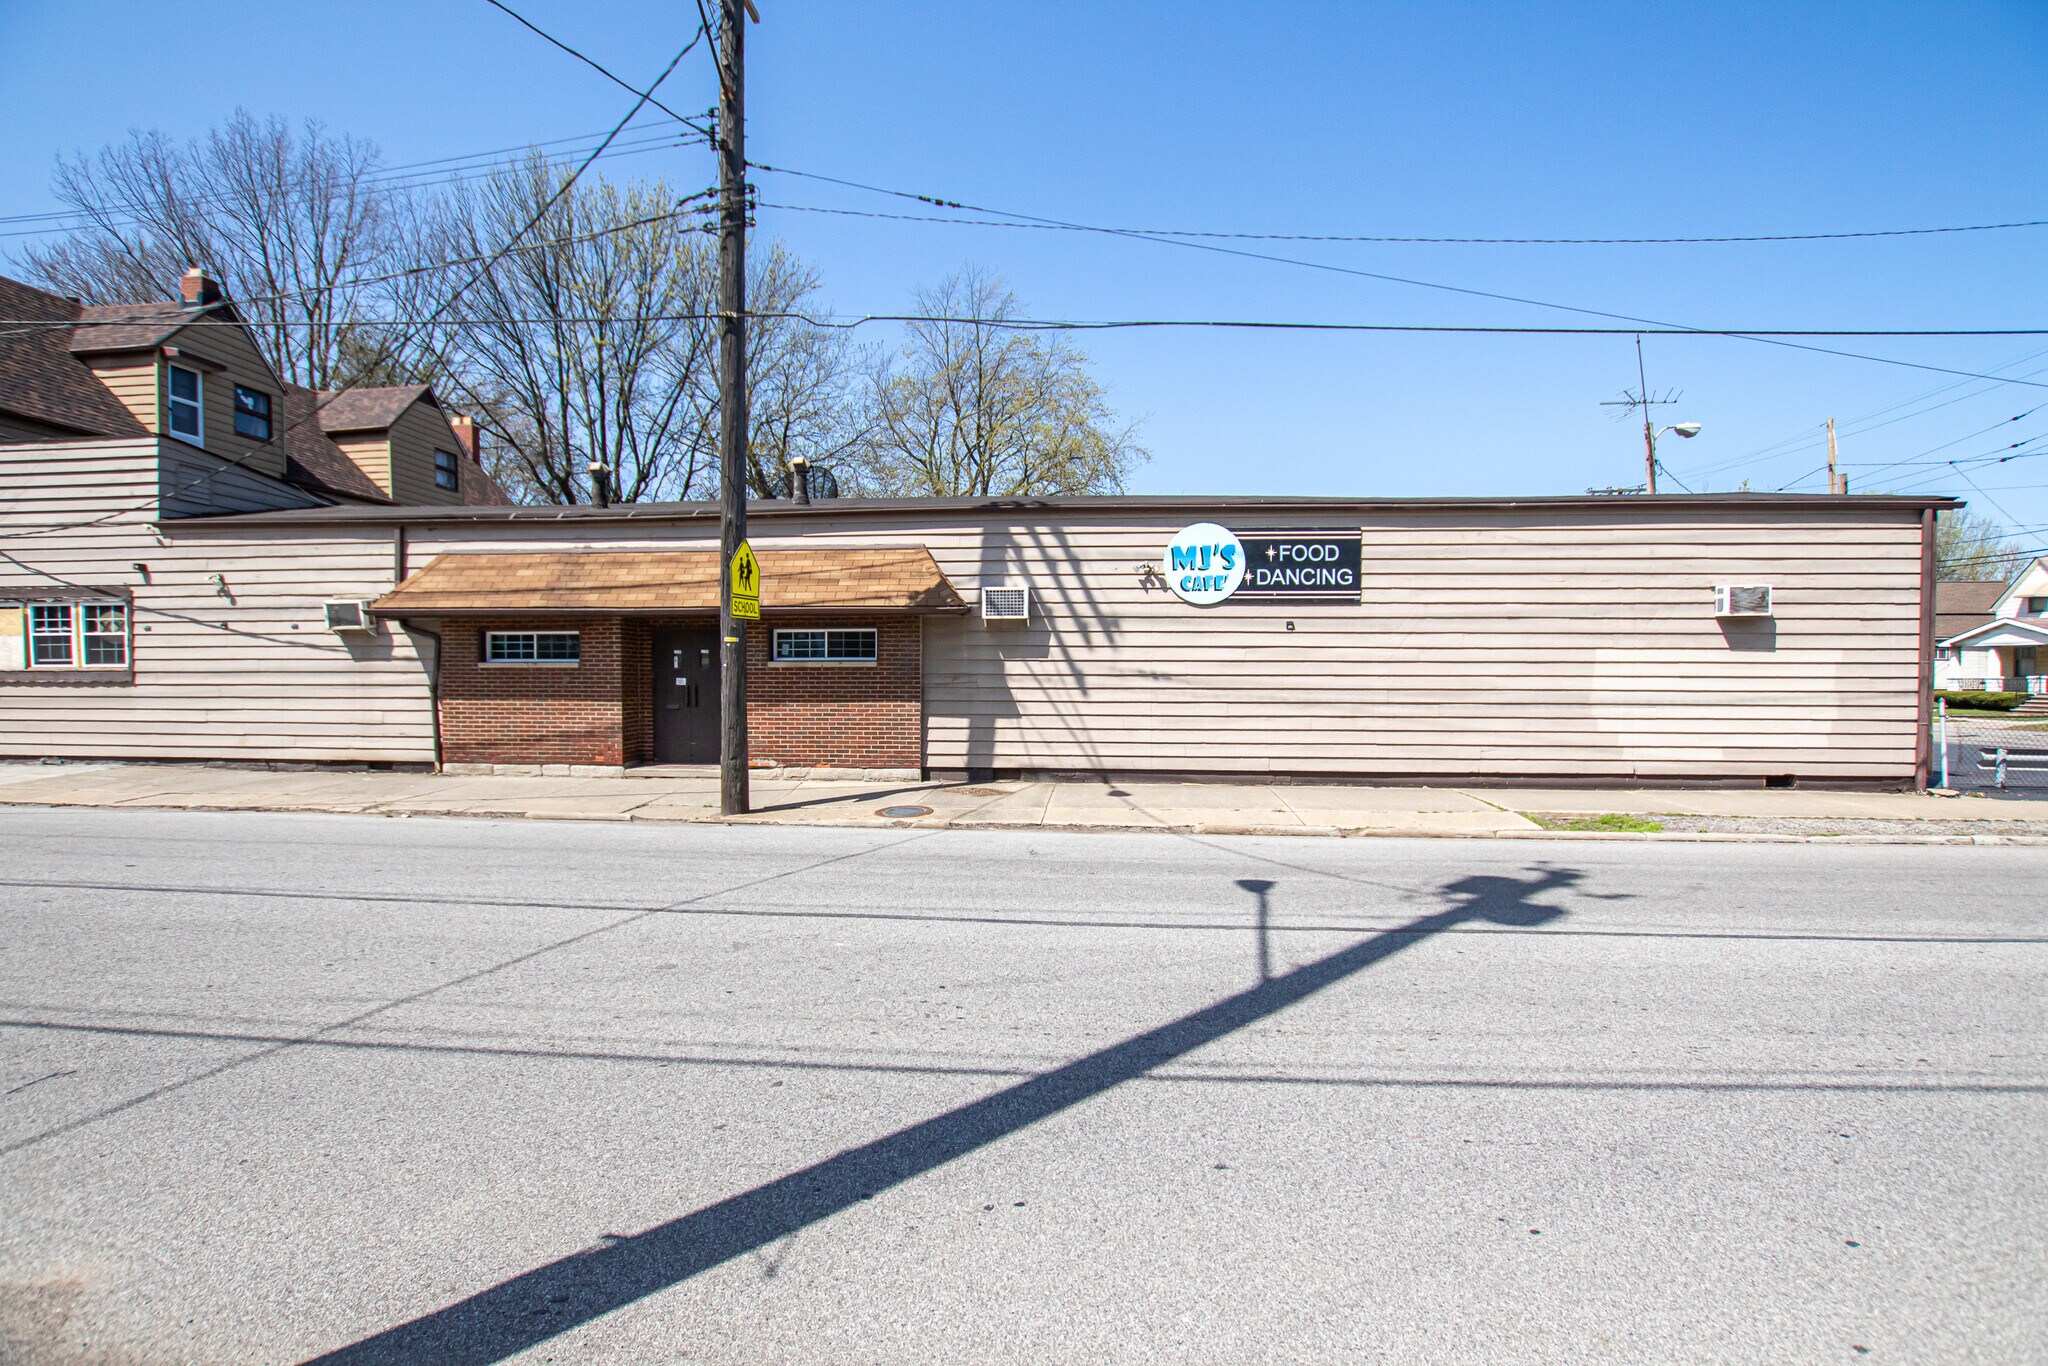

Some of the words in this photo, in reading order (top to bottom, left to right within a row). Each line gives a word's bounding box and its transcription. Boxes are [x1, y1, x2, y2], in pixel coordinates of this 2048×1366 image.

[1171, 542, 1236, 571] MJ'S
[1279, 544, 1340, 562] FOOD
[1256, 568, 1353, 586] DANCING
[734, 600, 757, 614] SCHOOL
